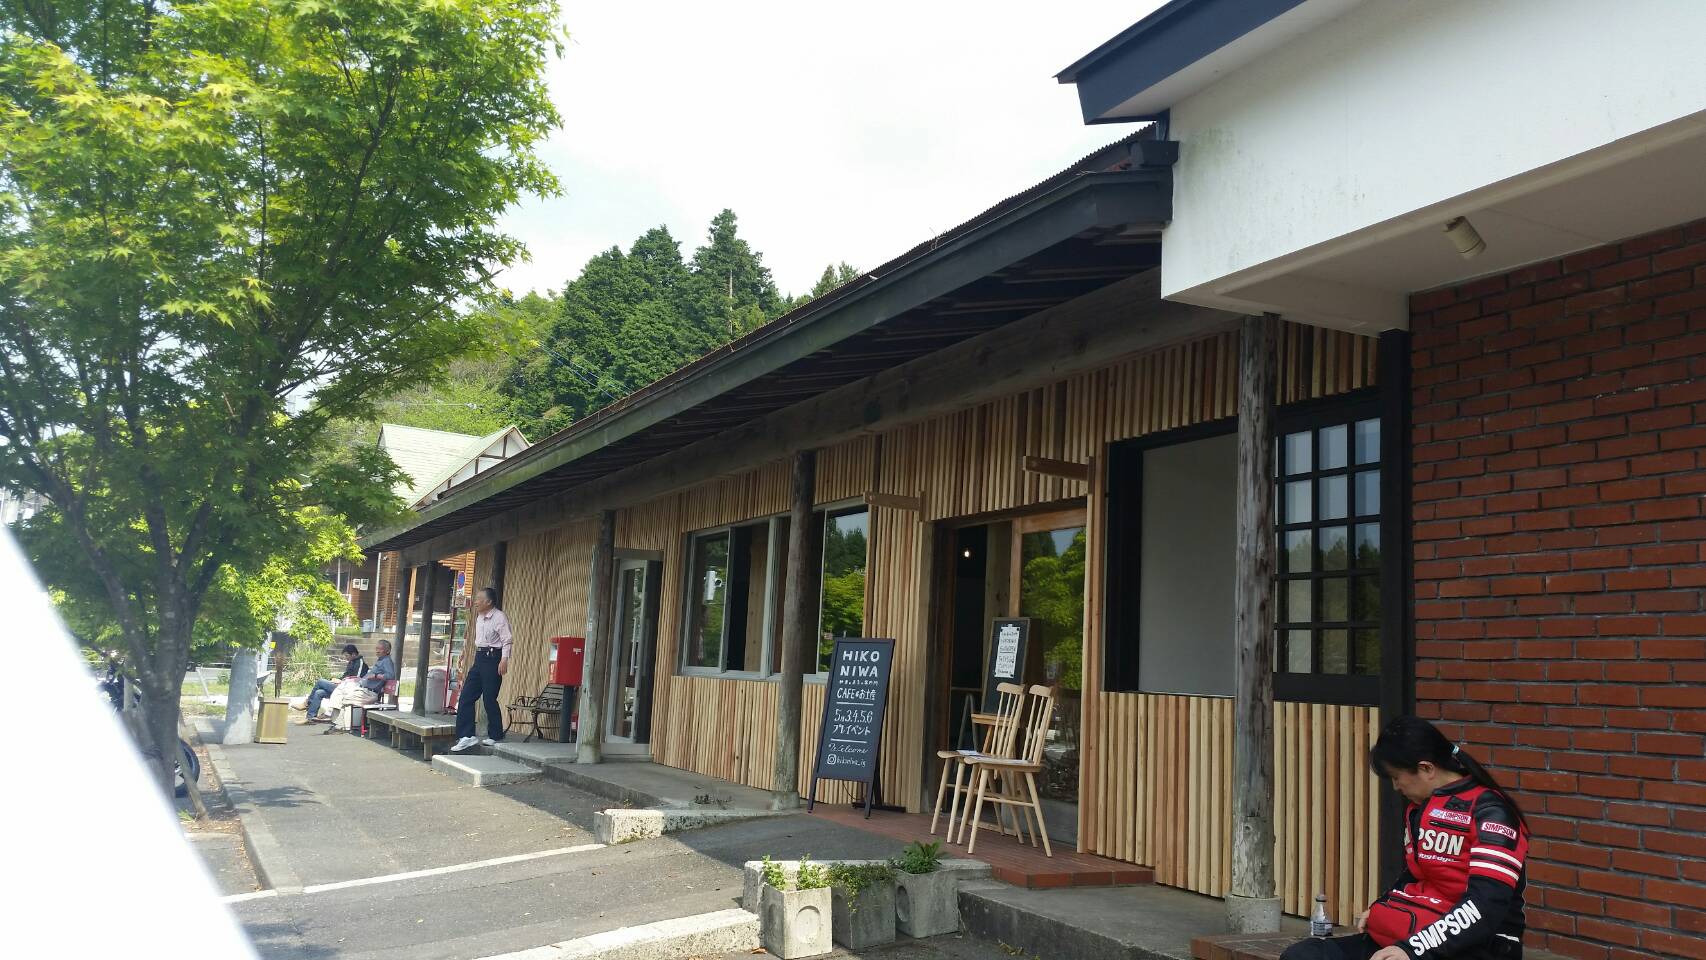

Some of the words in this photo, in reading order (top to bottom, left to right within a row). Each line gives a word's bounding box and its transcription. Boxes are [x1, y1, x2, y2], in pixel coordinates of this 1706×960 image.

[842, 650, 880, 662] HIKO
[839, 665, 878, 677] NIWA
[832, 723, 871, 736] プレイベント
[1443, 811, 1470, 822] SIMPSON
[1483, 822, 1516, 839] SIMPSON
[1408, 899, 1482, 957] SIMPSON
